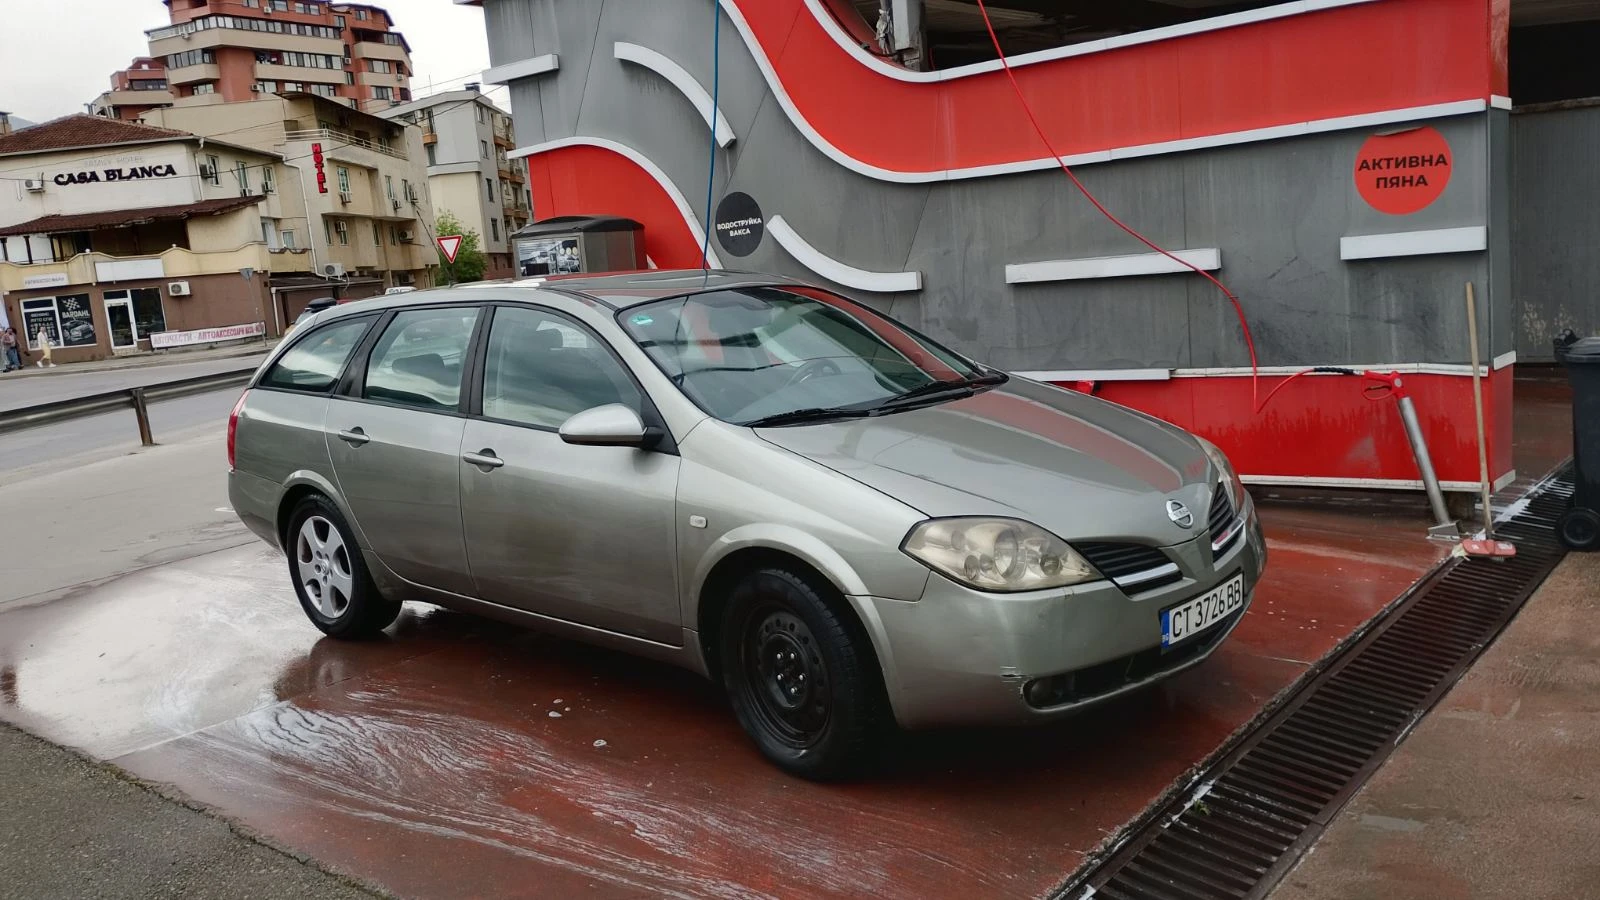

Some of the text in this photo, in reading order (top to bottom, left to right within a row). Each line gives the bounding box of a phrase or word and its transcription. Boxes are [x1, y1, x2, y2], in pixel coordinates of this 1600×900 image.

[312, 143, 328, 193] HOTEL
[1358, 153, 1448, 171] АКТИВНА
[54, 164, 177, 186] CASA BLANCA
[1376, 175, 1428, 189] ПЯНА
[717, 217, 762, 230] ВОДОСТРУЙКА
[729, 228, 750, 236] ВАКСА
[62, 310, 90, 319] BARDAHL
[1172, 579, 1241, 638] CT 3726 BB
